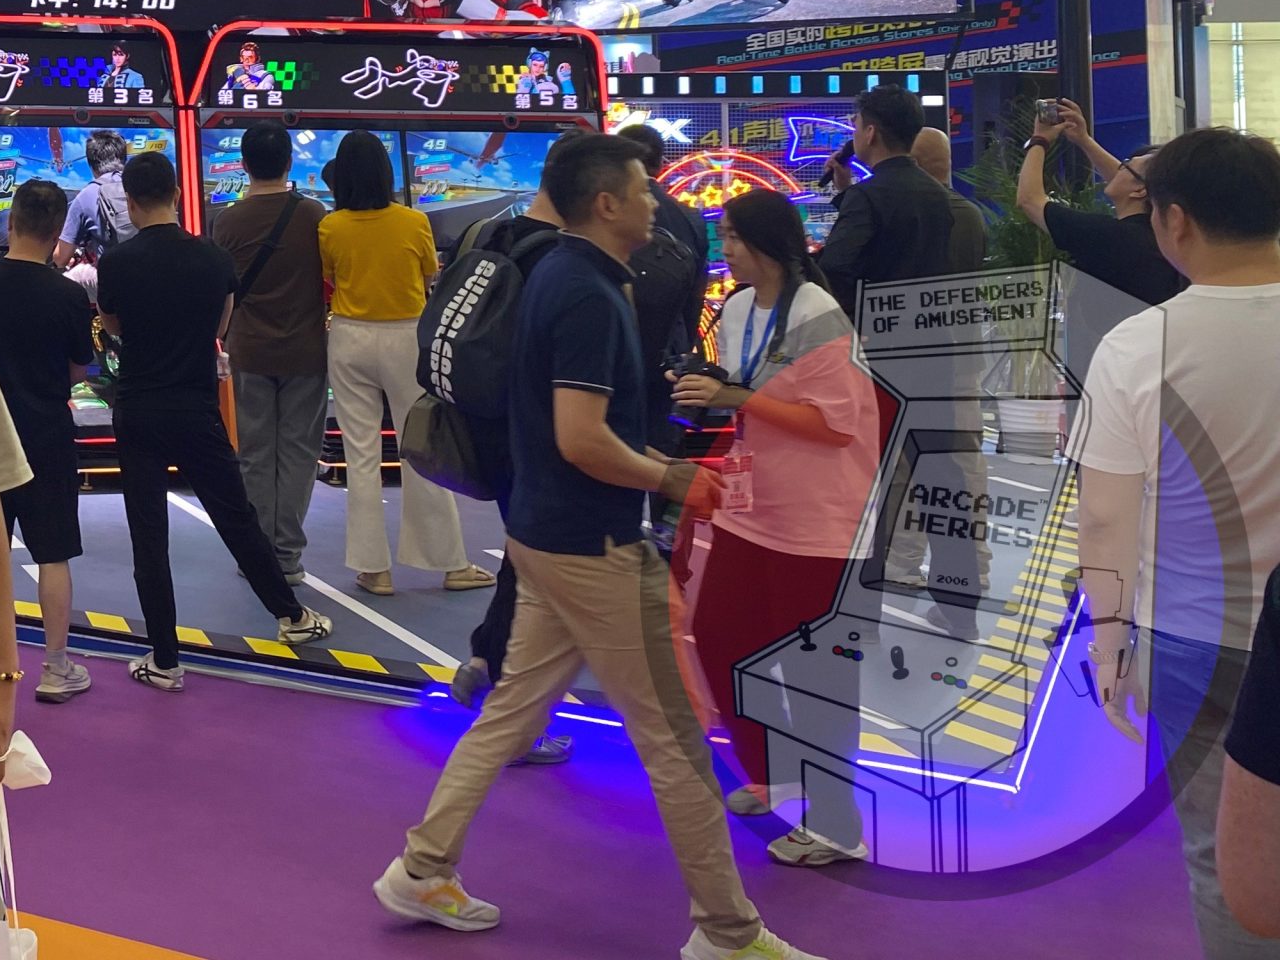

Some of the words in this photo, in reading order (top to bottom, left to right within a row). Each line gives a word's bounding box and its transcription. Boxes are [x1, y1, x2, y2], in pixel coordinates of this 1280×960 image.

[717, 49, 783, 65] Real-Time
[784, 43, 826, 56] Battle
[830, 36, 880, 49] Across
[883, 28, 934, 42] Stores
